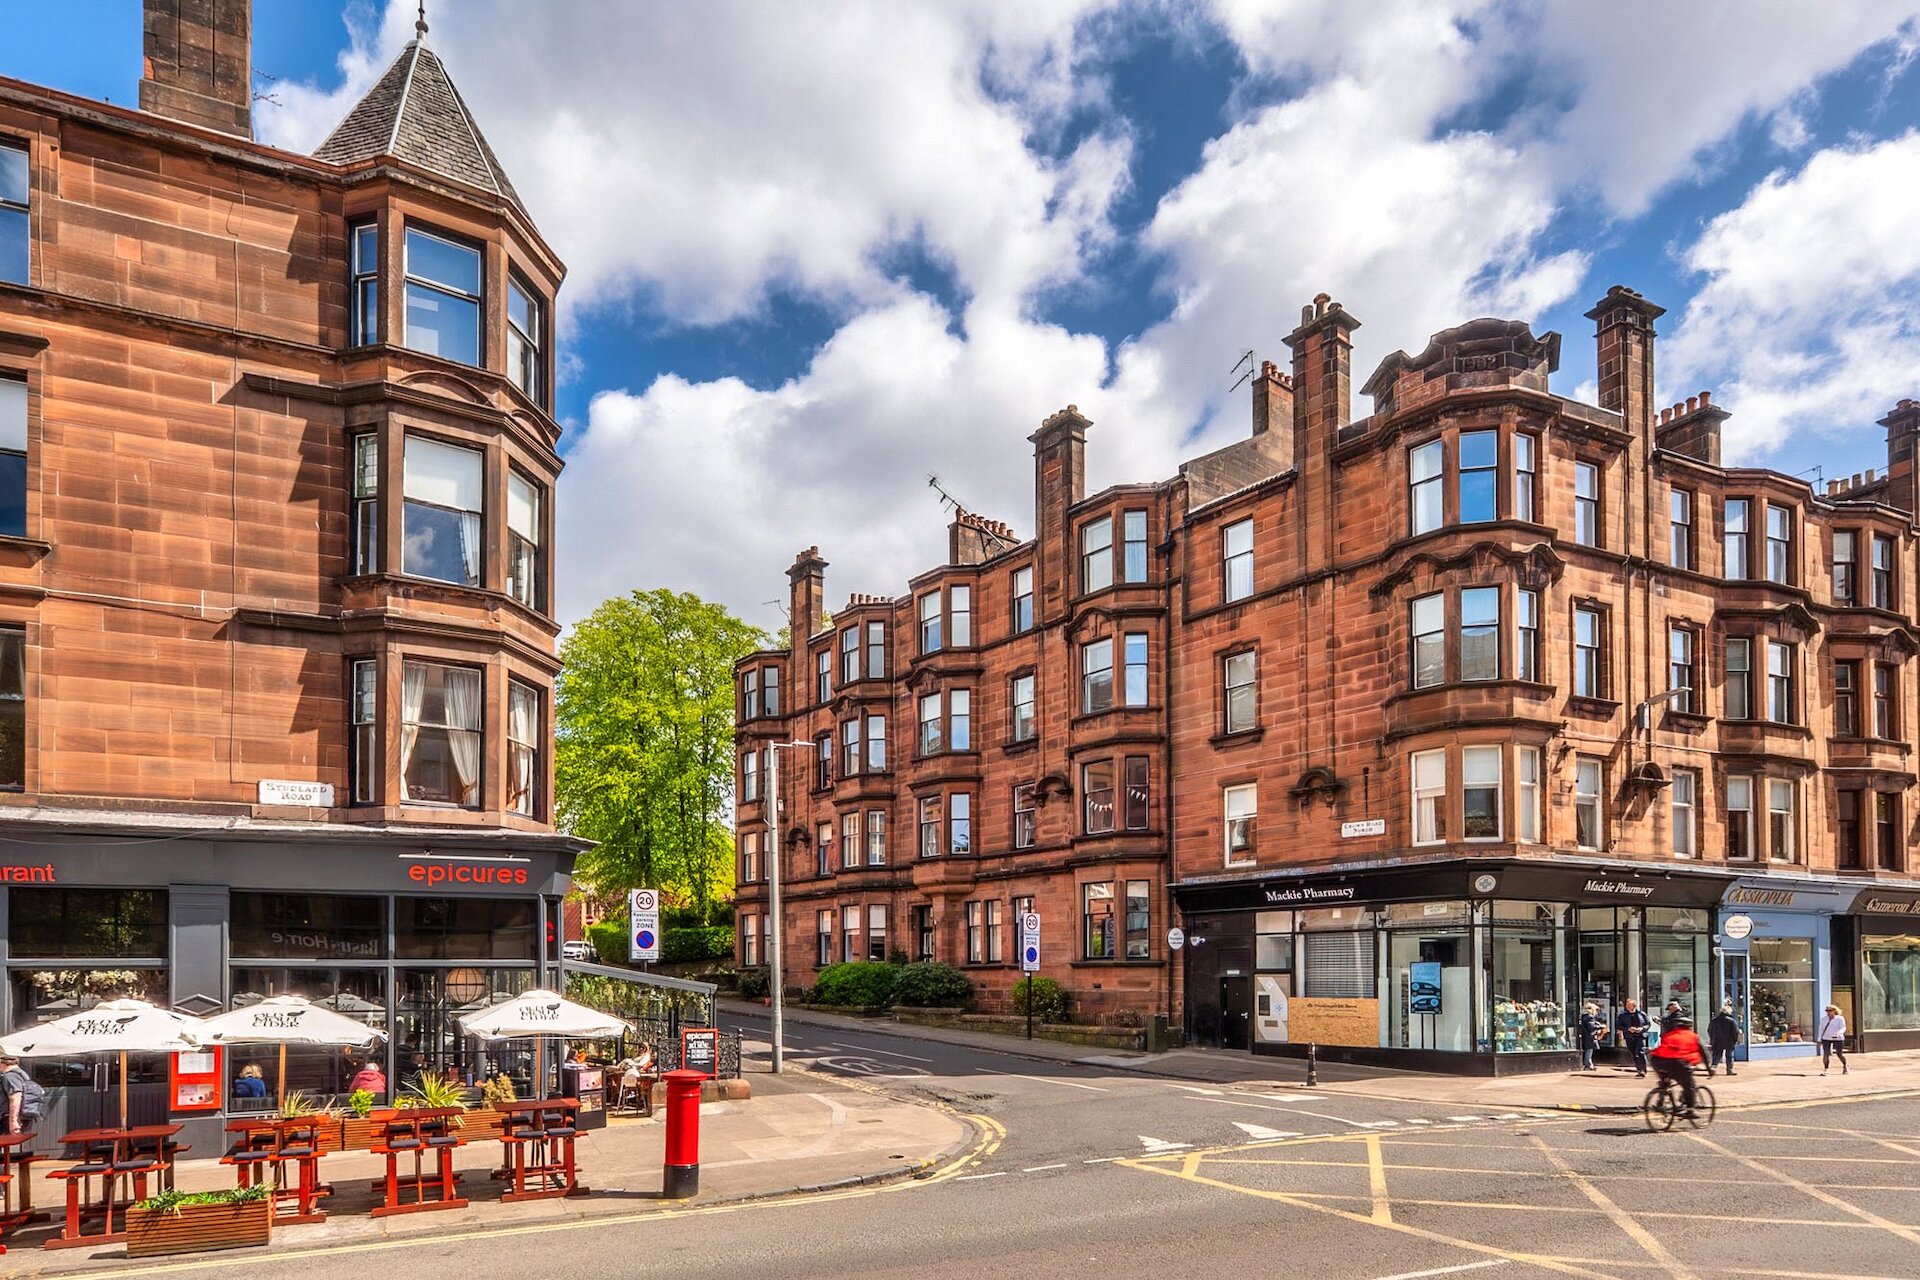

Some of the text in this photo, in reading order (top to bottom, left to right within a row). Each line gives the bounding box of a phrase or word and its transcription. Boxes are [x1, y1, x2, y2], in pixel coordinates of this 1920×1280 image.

[1462, 356, 1496, 372] 1902
[281, 792, 313, 801] ROAD
[0, 864, 56, 882] rant
[408, 862, 528, 887] epicures
[1265, 887, 1355, 902] Mackie Pharmacy
[1584, 880, 1655, 898] Mackie Pharmacy
[1727, 887, 1794, 905] CASSIOPEIA
[639, 896, 652, 905] 20
[1866, 898, 1910, 913] Cameron
